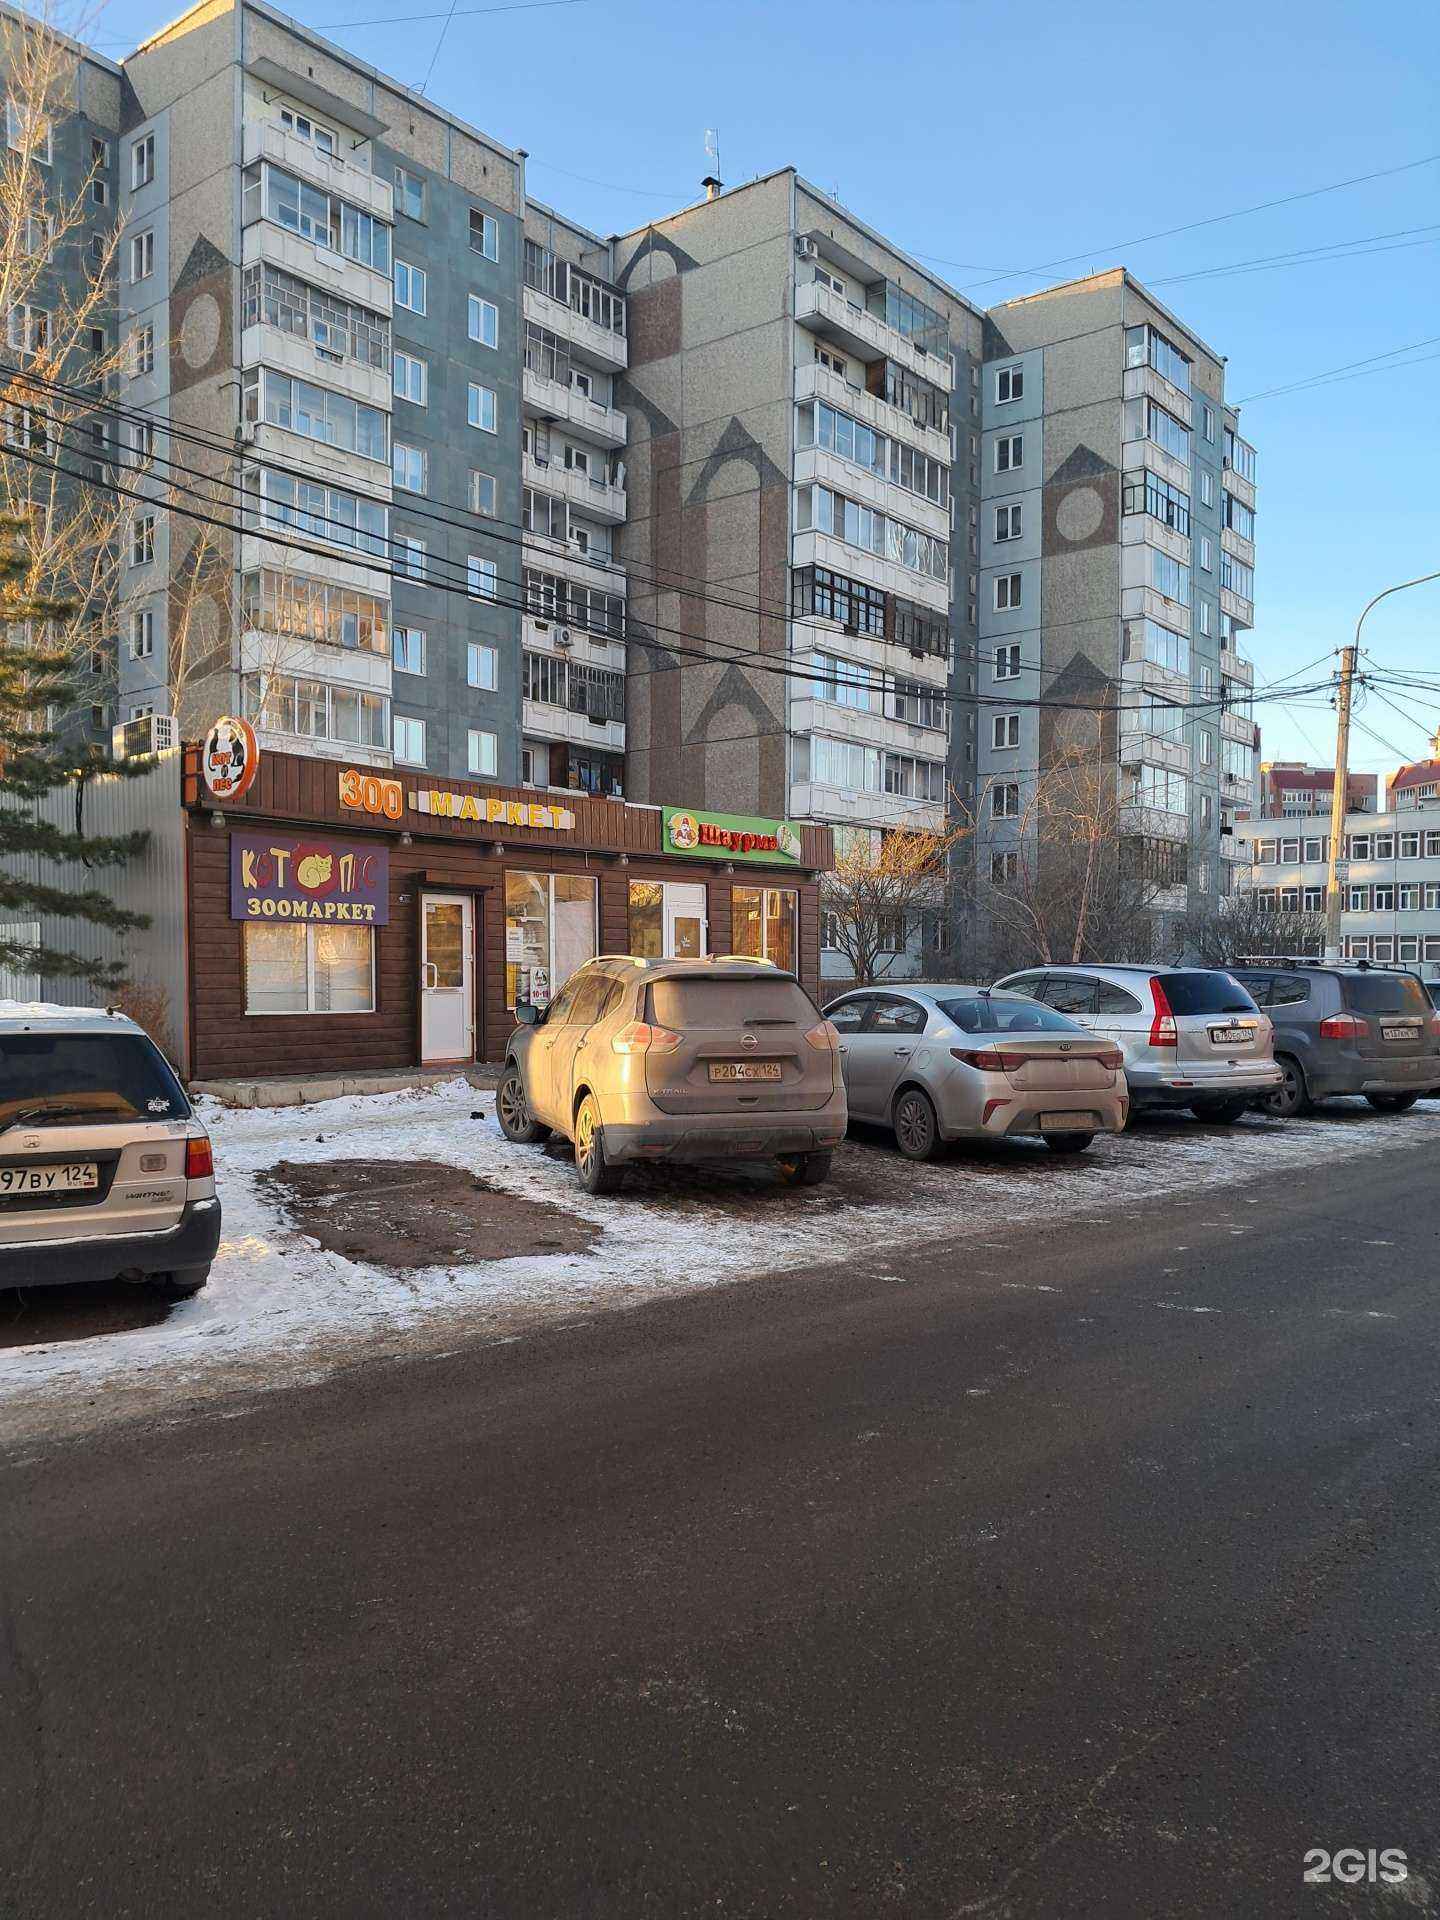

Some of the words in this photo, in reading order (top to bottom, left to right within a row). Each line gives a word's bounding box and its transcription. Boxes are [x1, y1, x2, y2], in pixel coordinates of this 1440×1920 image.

[211, 752, 231, 766] КОТ
[343, 769, 402, 820] ЗОО
[429, 790, 564, 829] МАРКЕТ
[700, 823, 778, 853] Шаурма
[247, 897, 376, 920] ЗООМАРКЕТ
[61, 1166, 95, 1181] 124
